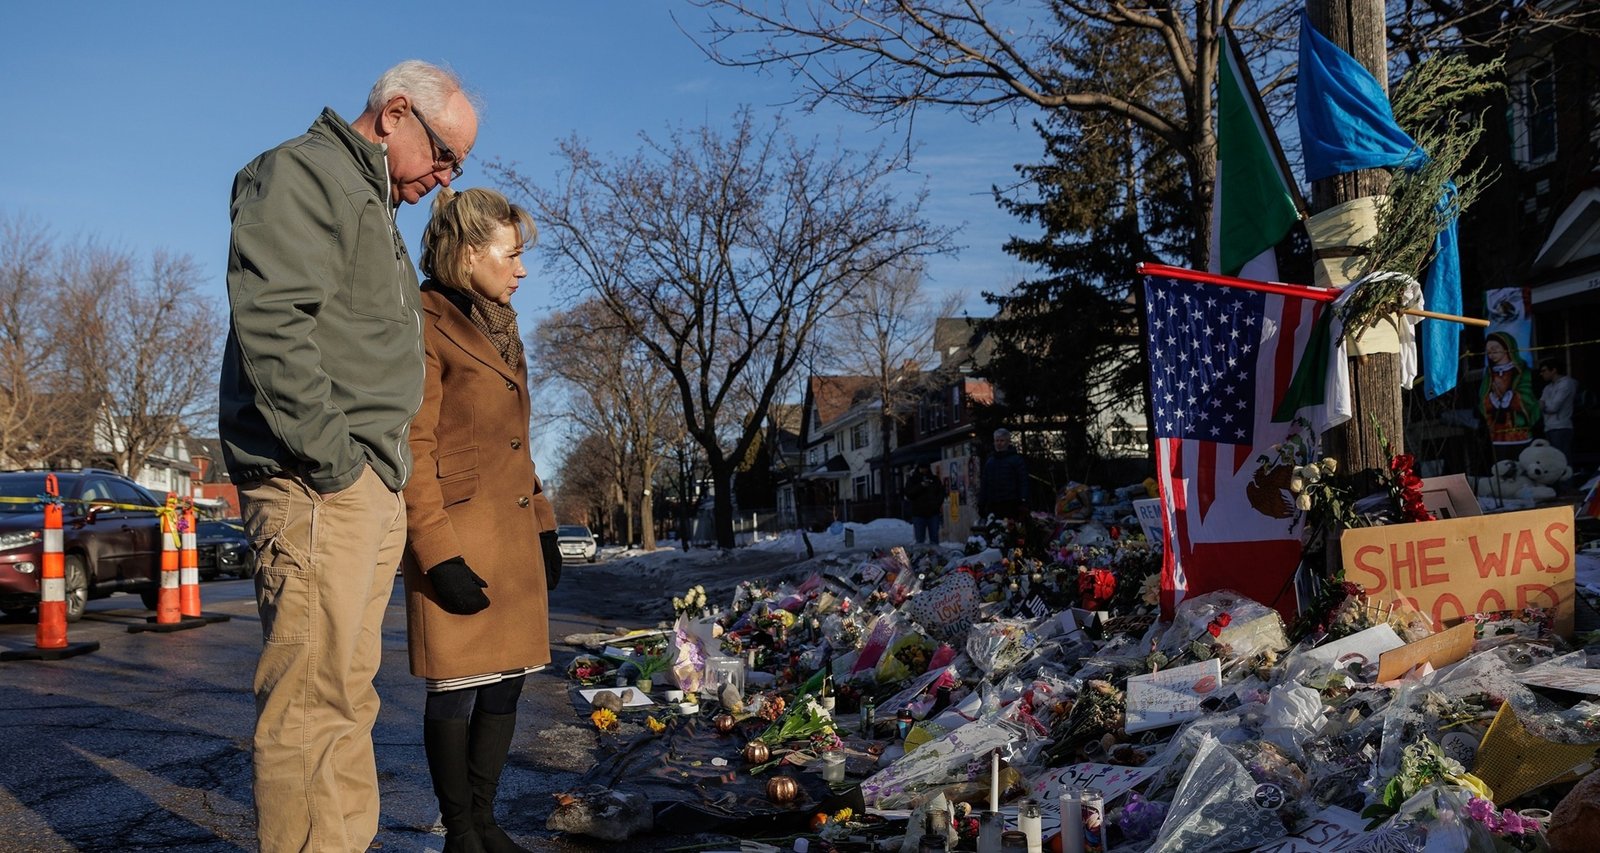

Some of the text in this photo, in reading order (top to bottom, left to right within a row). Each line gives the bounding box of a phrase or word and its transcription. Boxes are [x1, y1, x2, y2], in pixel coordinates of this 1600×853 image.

[1354, 522, 1571, 595] SHE WAS
[937, 601, 964, 621] LOVE
[944, 616, 971, 636] HUGS
